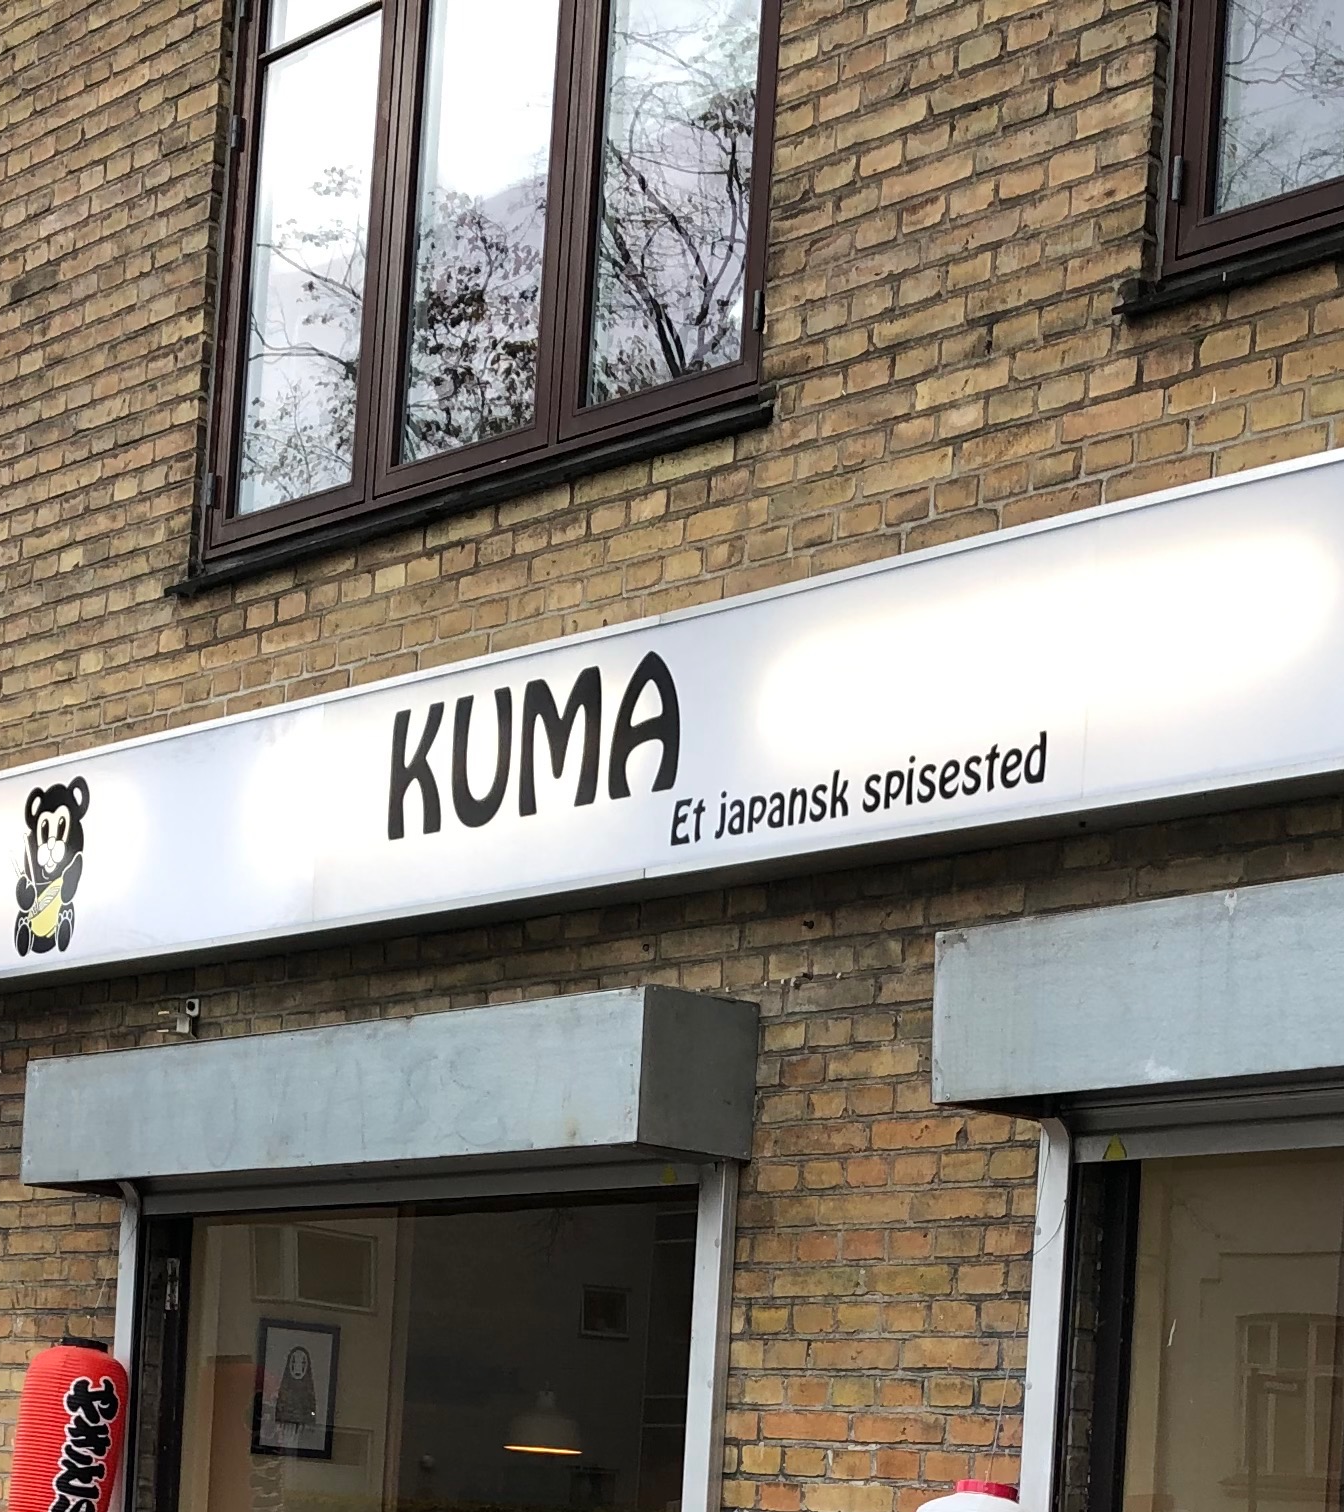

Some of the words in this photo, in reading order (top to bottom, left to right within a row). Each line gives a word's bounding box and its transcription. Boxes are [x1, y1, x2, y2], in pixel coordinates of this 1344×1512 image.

[388, 650, 682, 841] KUMA
[669, 796, 706, 846] Et
[714, 769, 849, 841] japansk
[861, 729, 1048, 811] spisested
